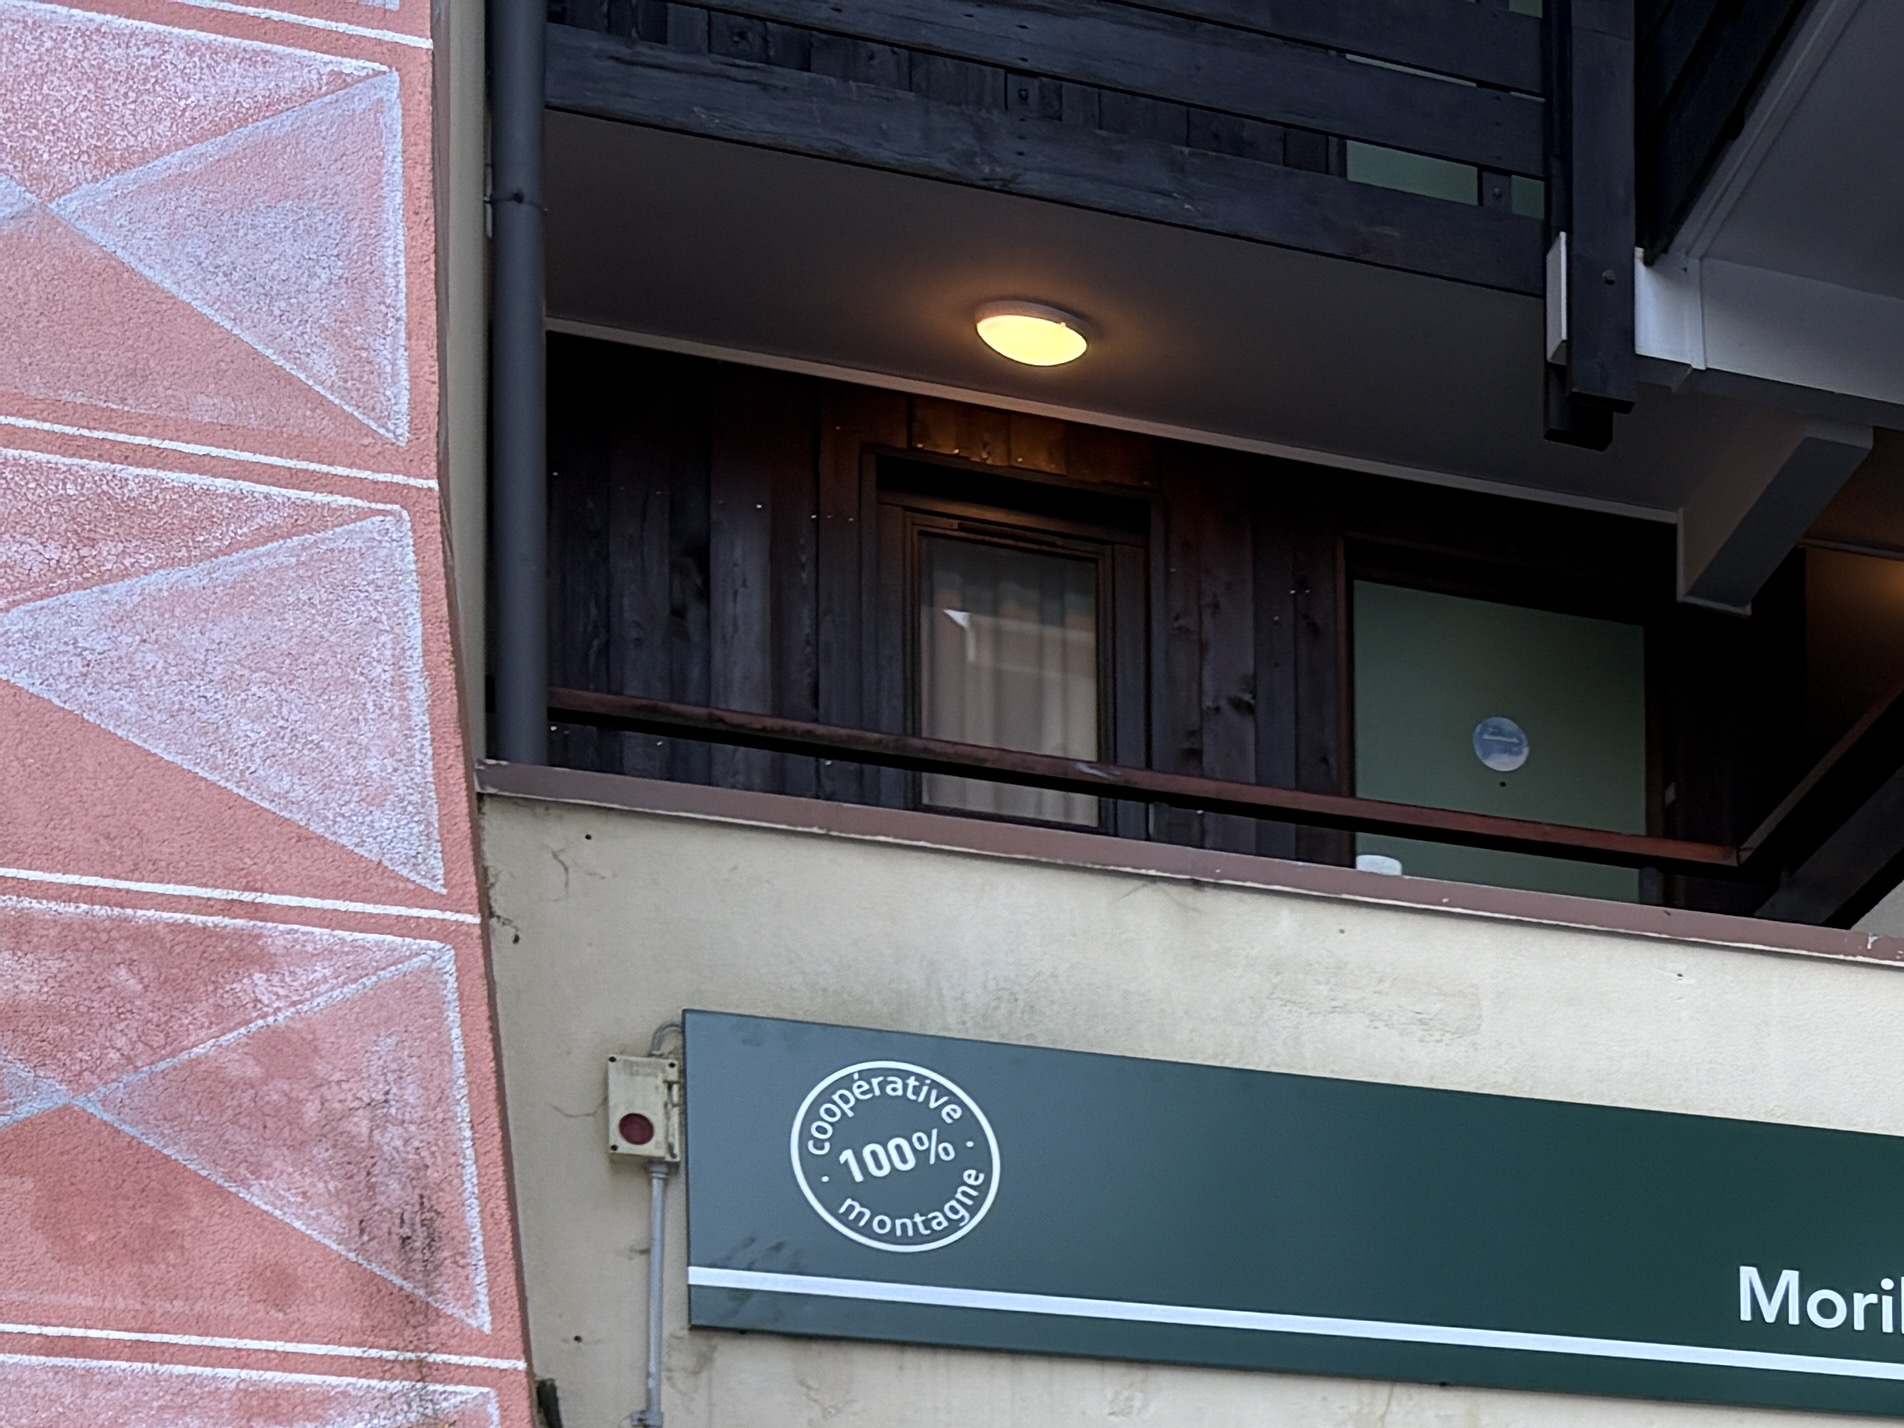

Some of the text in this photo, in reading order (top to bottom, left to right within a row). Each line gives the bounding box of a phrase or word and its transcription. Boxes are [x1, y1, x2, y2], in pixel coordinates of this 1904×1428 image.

[808, 1073, 962, 1156] coopérative
[838, 1128, 955, 1183] 100%
[838, 1168, 985, 1237] montagne
